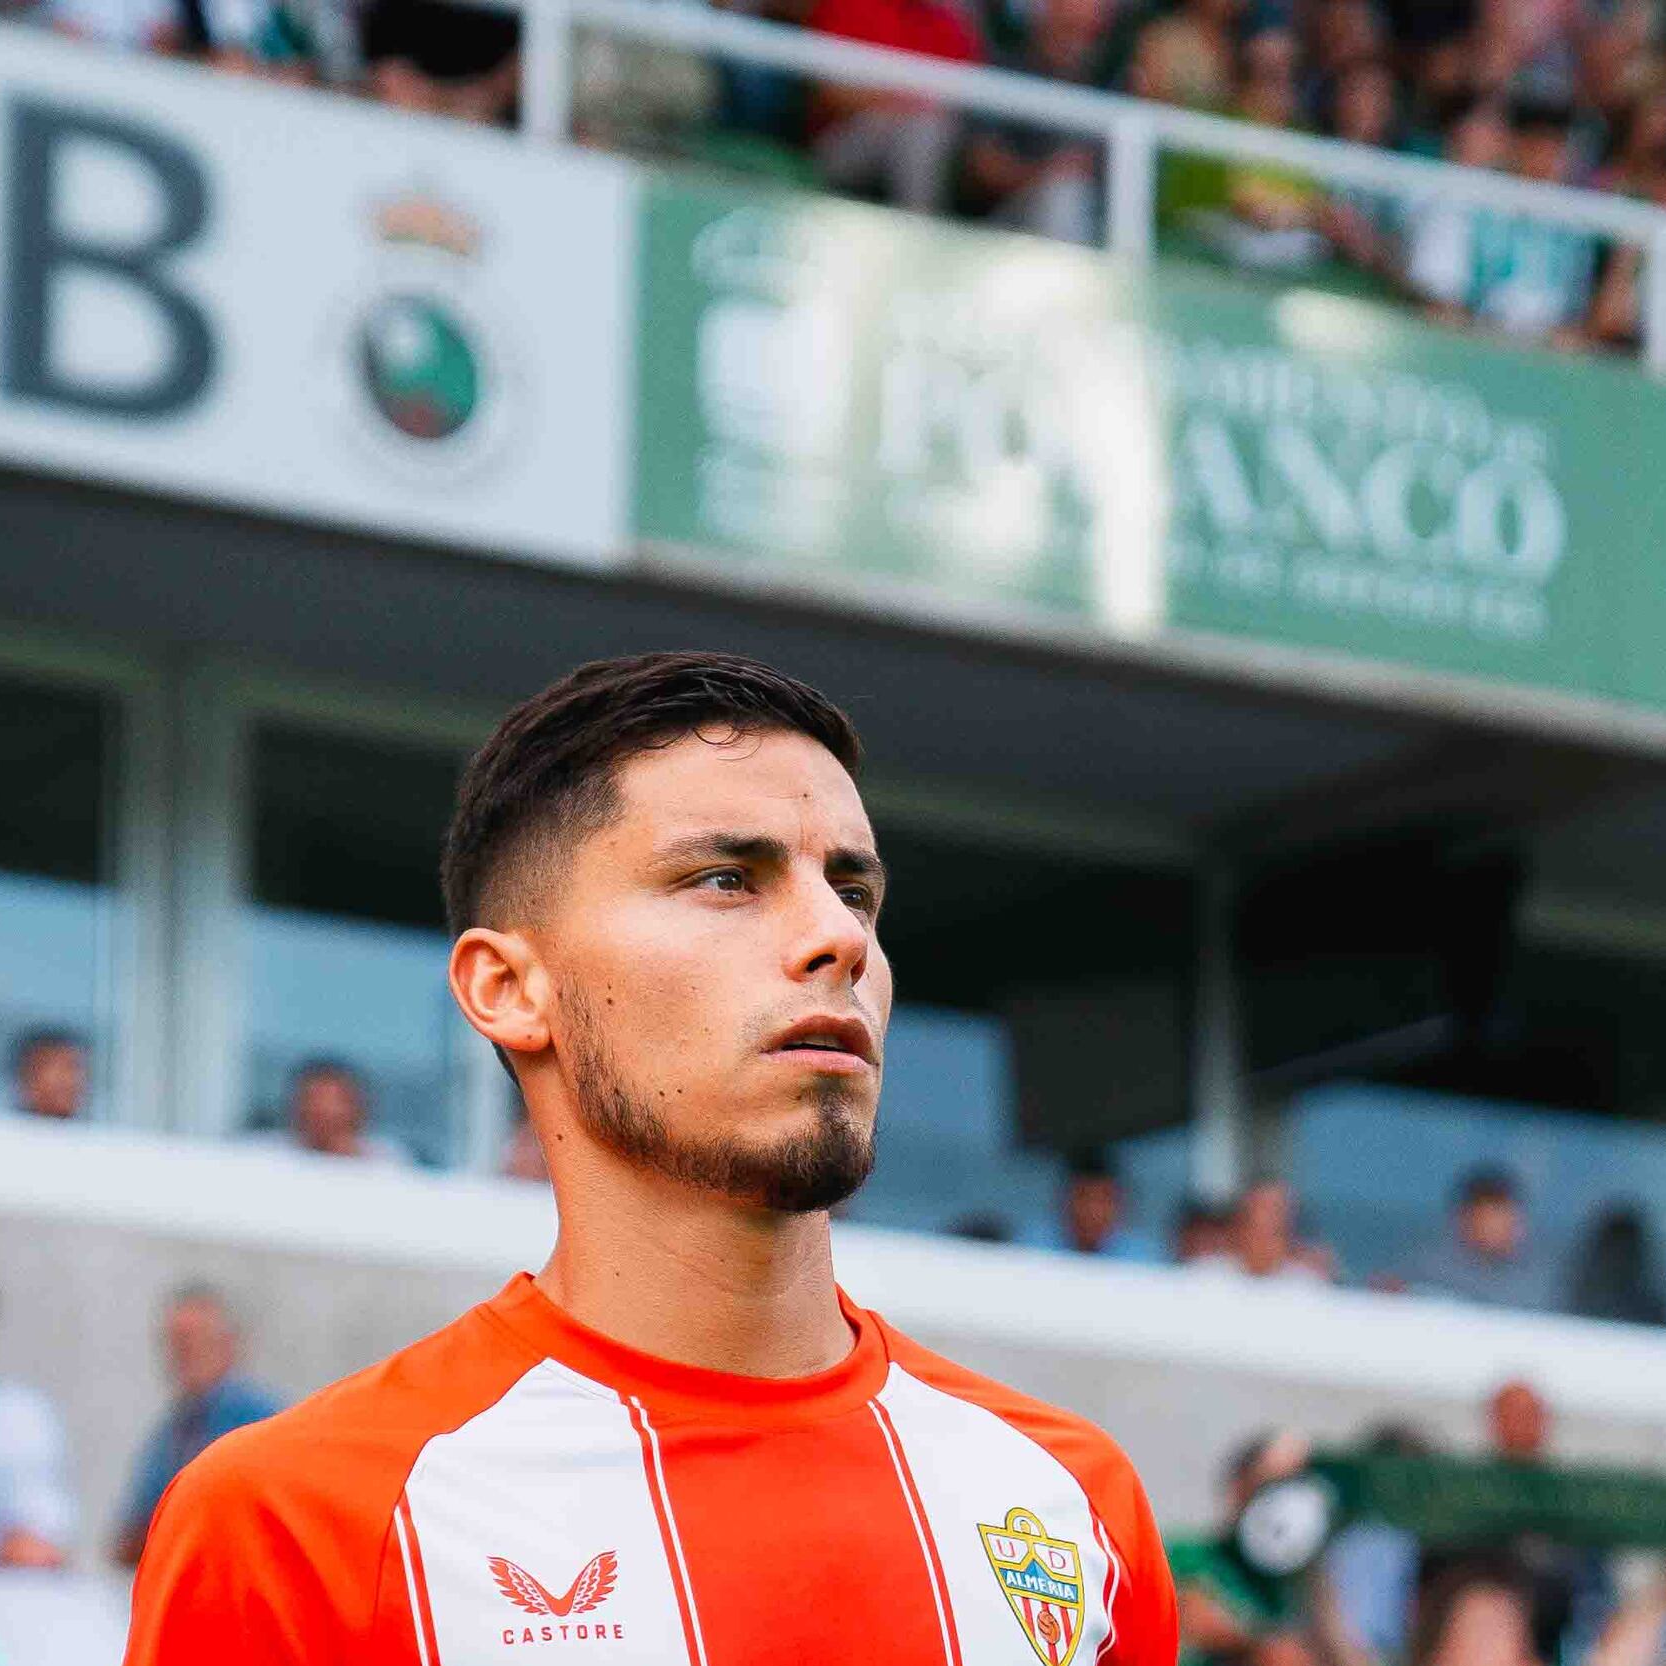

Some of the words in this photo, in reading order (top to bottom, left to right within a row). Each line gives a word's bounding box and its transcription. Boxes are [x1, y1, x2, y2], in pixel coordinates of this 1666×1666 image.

[877, 343, 1568, 580] POANCO
[996, 1538, 1016, 1558] U
[1048, 1550, 1067, 1570] D
[1006, 1570, 1076, 1600] ALMERIA
[503, 1624, 625, 1646] CASTORE
